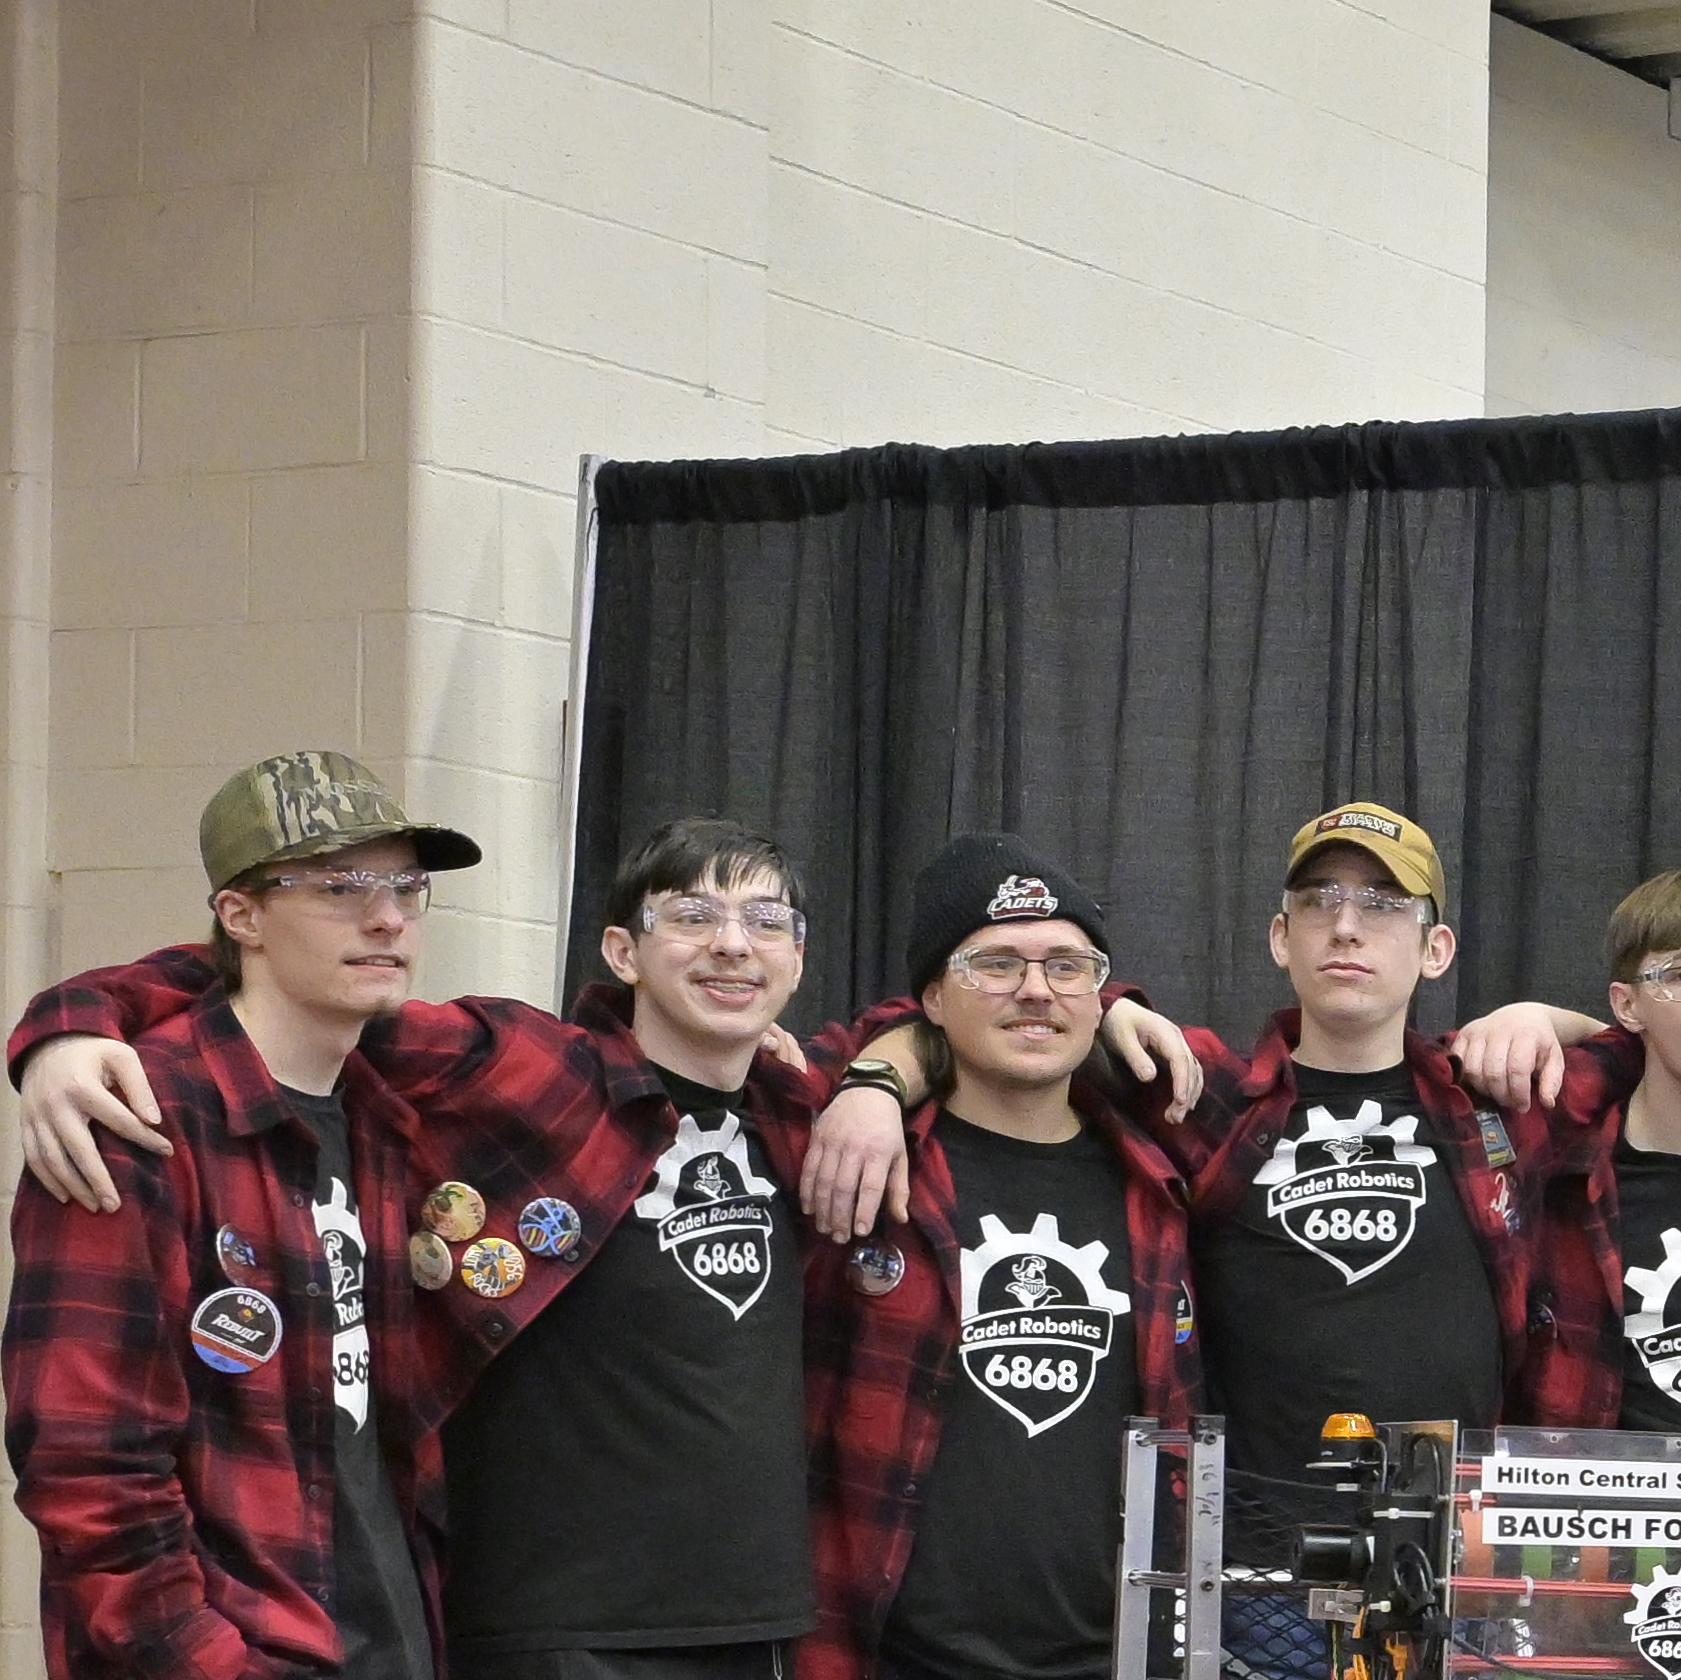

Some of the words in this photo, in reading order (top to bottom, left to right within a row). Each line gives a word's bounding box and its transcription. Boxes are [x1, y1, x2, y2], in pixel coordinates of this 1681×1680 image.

[991, 898, 1057, 912] CADETS
[1279, 1177, 1333, 1201] Cadet
[1336, 1169, 1415, 1189] Robotics
[668, 1212, 707, 1236] Cadet
[709, 1203, 762, 1223] Robotics
[1304, 1208, 1397, 1242] 6868
[694, 1242, 760, 1276] 6868
[237, 1294, 266, 1314] 6868
[962, 1320, 1017, 1343] Cadet
[1019, 1317, 1102, 1340] Robotics
[985, 1354, 1078, 1393] 6868
[1497, 1467, 1570, 1486] Hilton
[1579, 1469, 1667, 1490] Central
[1498, 1515, 1632, 1540] BAUSCH
[1638, 1622, 1666, 1634] Cadet
